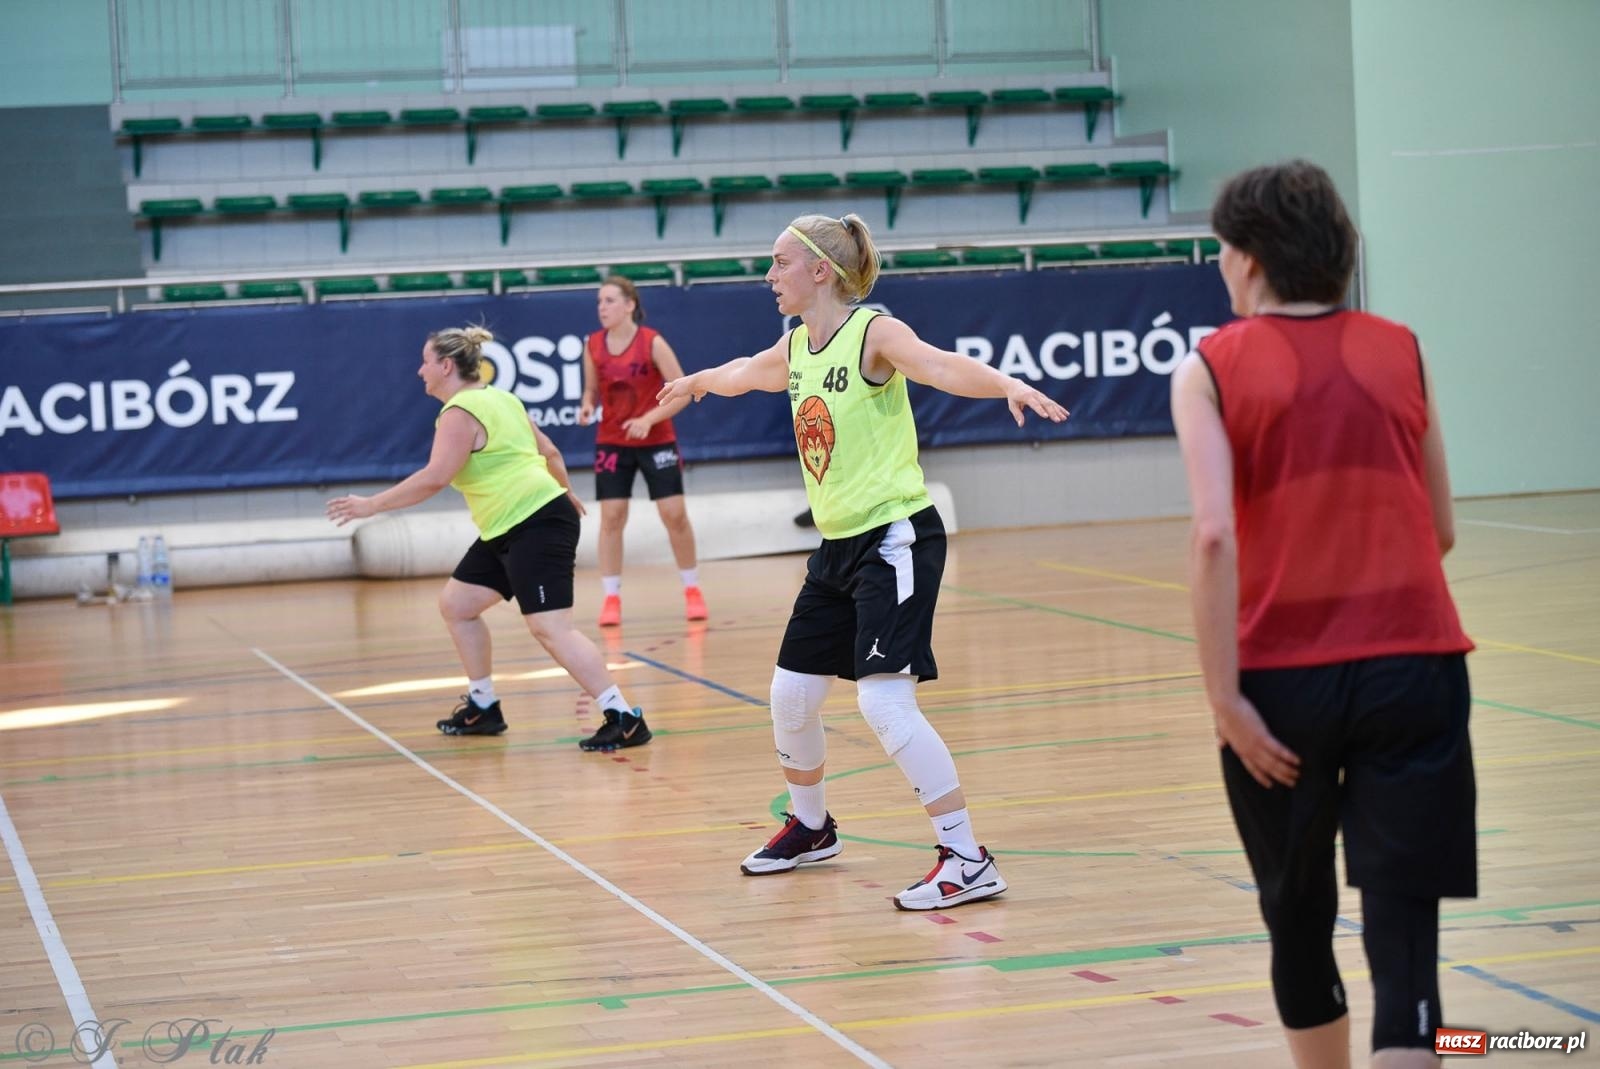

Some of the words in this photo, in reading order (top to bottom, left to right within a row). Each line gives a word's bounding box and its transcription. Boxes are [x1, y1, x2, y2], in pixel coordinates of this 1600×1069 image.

[822, 366, 849, 393] 48
[0, 359, 298, 437] ACIBÓRZ
[594, 451, 618, 473] 24
